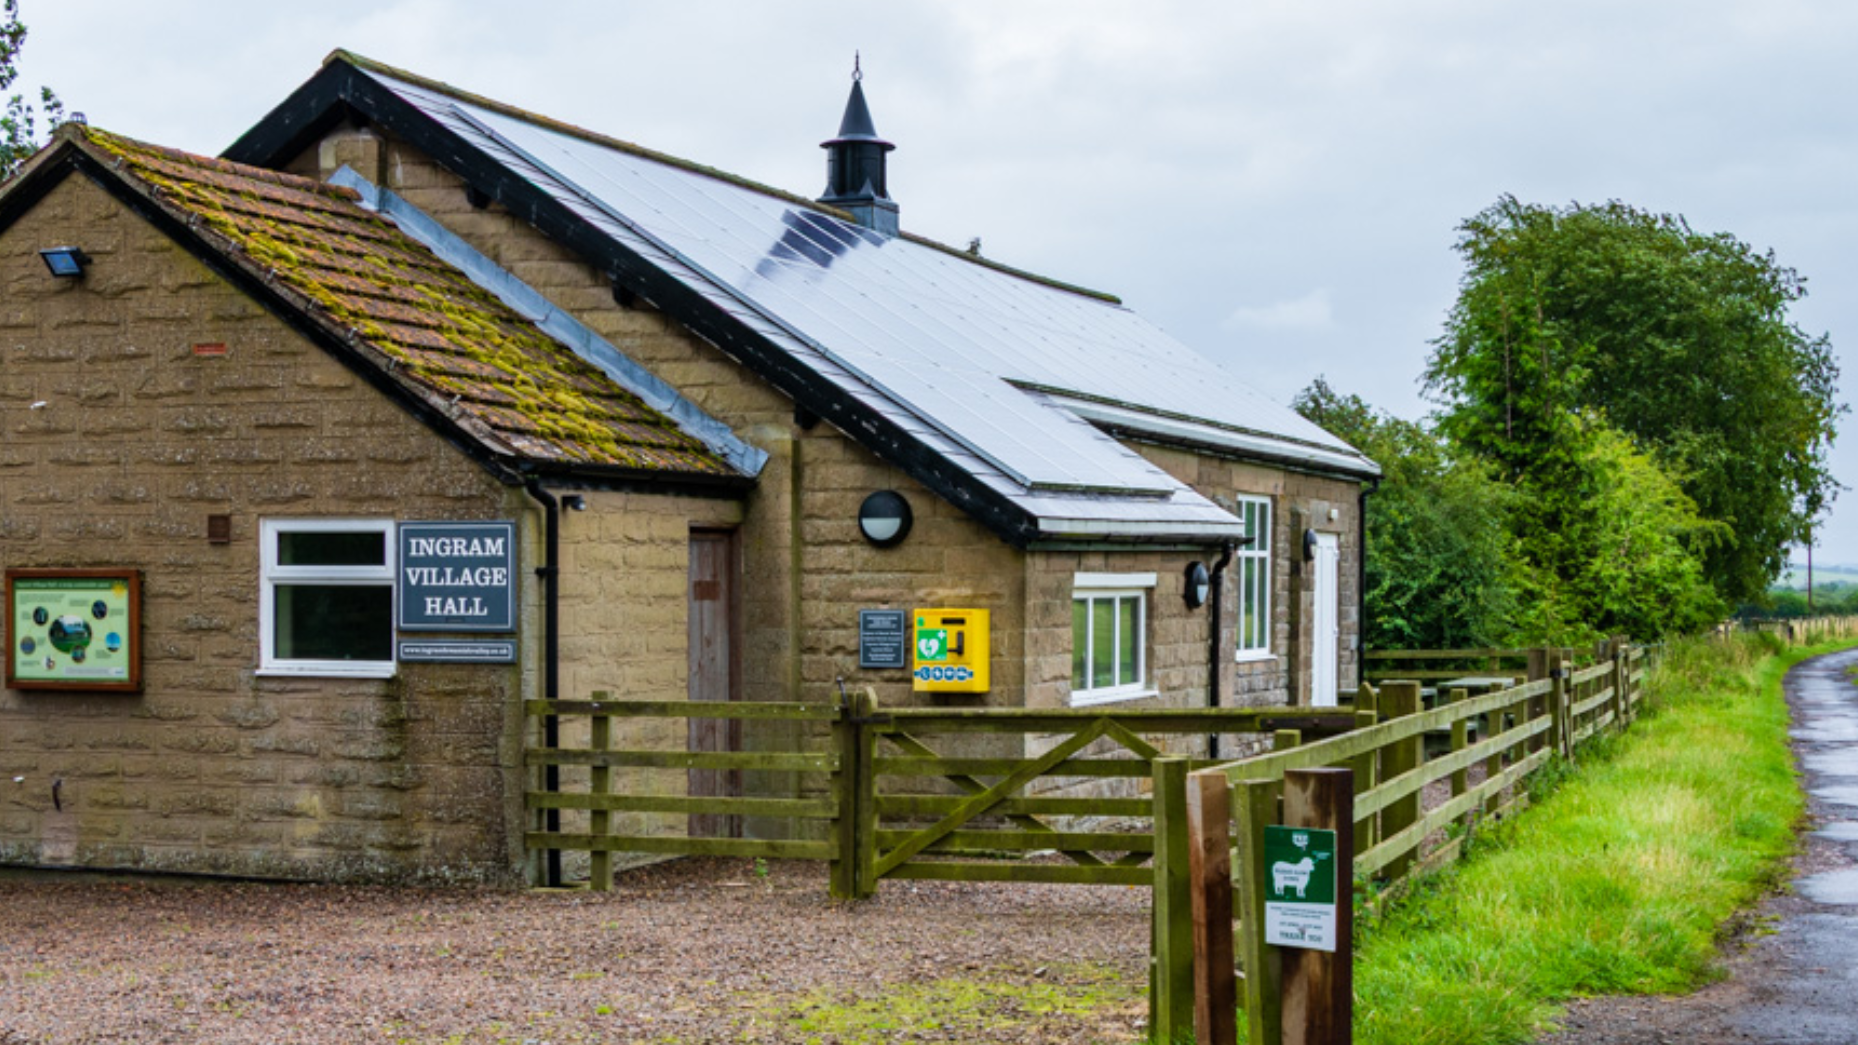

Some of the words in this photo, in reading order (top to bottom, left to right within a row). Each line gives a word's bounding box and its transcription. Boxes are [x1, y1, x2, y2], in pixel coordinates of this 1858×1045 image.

[409, 537, 505, 557] INGRAM
[405, 567, 507, 587] VILLAGE
[424, 597, 488, 616] HALL
